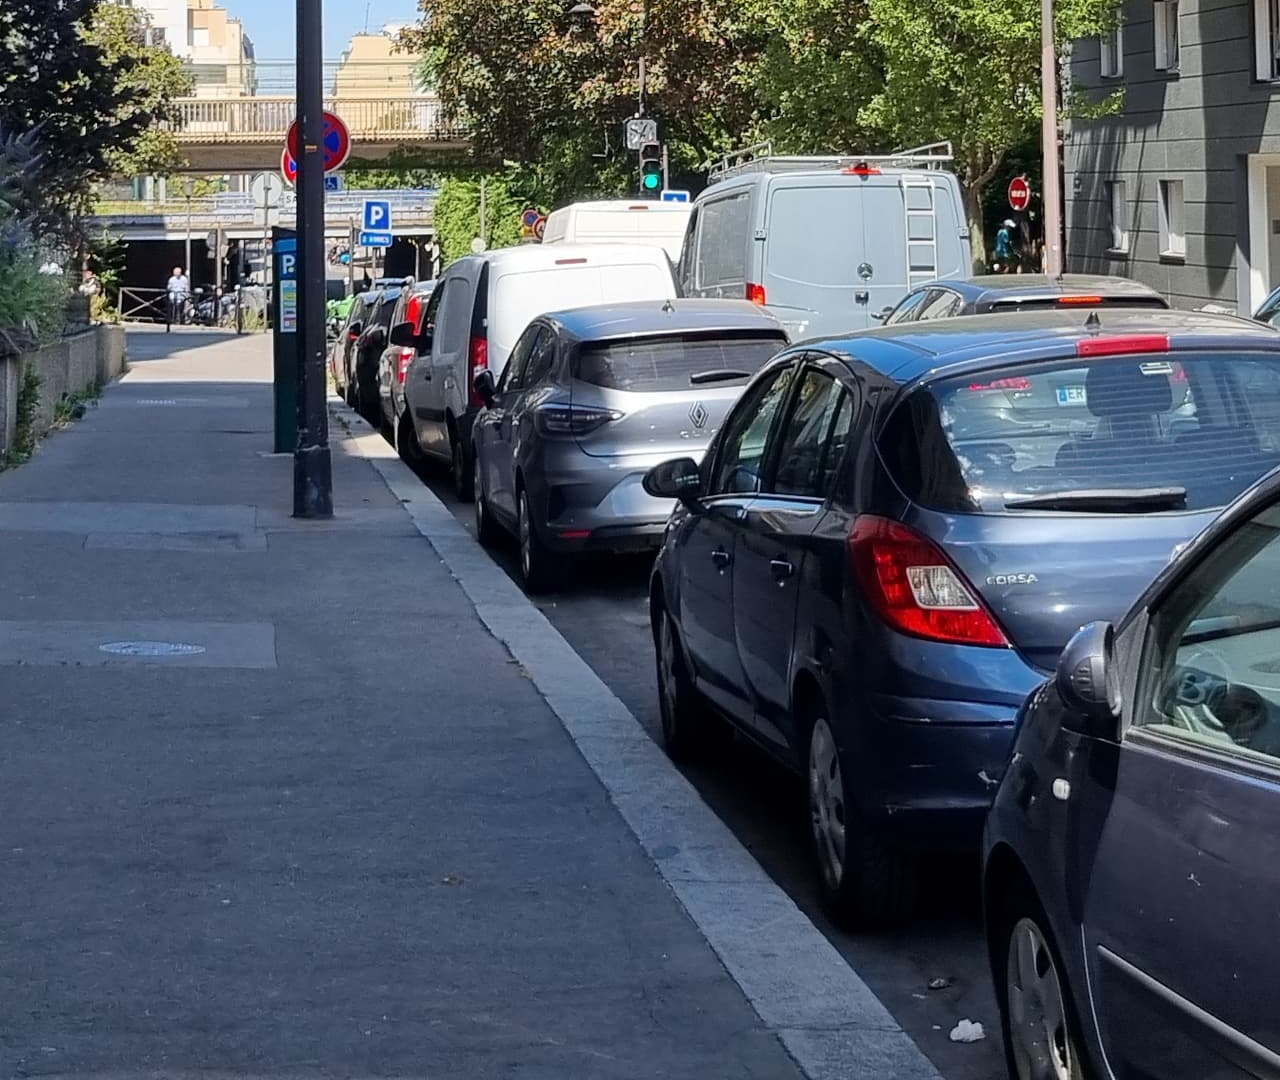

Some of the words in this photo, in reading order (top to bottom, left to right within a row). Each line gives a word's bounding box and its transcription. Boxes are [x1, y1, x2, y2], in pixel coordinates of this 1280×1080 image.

[370, 205, 384, 226] P
[282, 254, 296, 275] P
[986, 573, 1039, 585] CORSA
